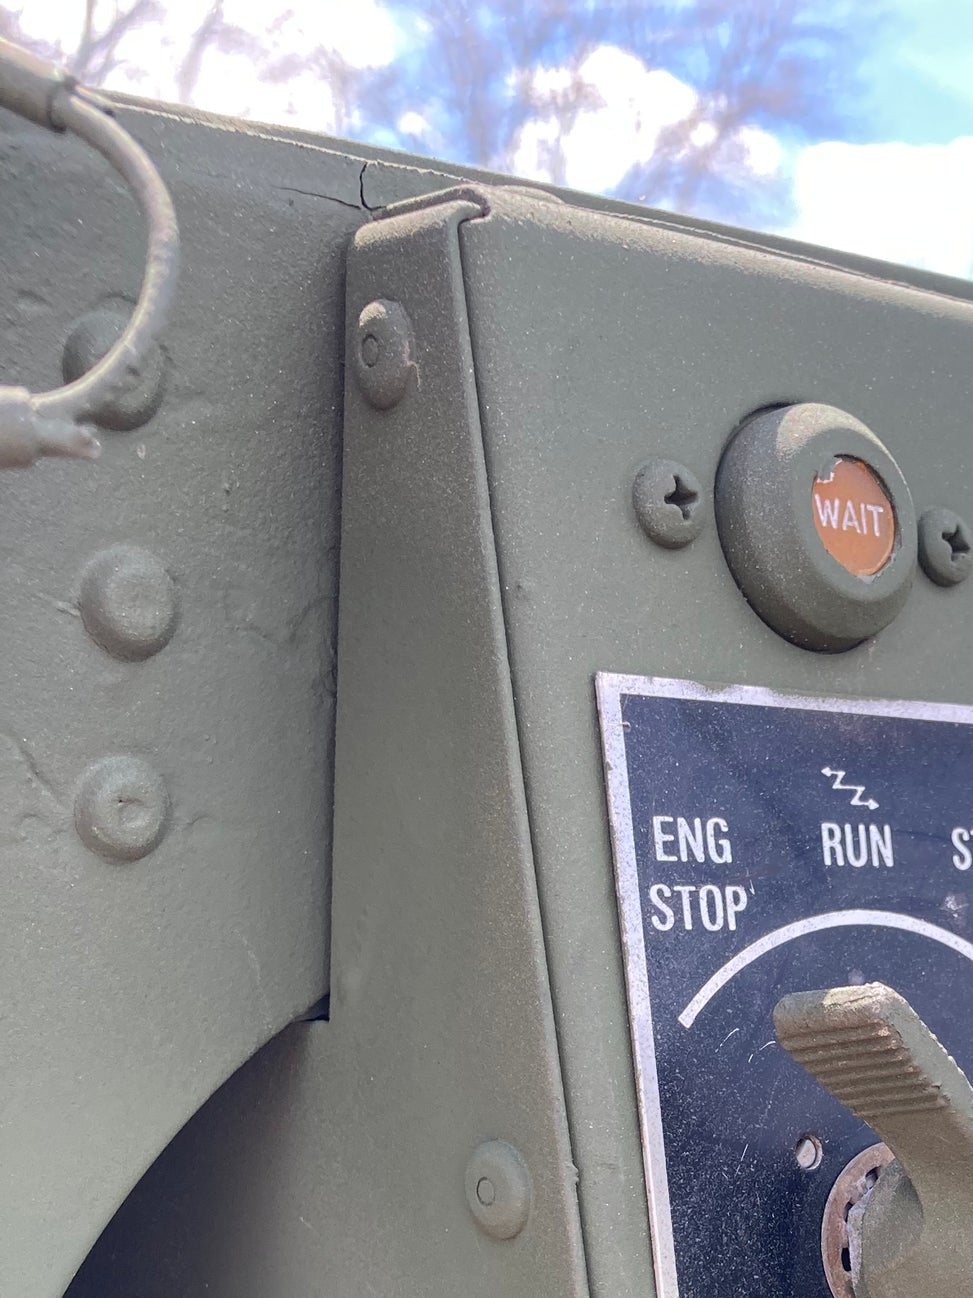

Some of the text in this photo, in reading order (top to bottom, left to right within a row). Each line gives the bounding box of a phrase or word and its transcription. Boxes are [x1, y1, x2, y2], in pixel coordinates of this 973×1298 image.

[813, 492, 885, 538] WAIT
[652, 816, 734, 864] ENG
[820, 821, 895, 868] RUN
[648, 884, 748, 932] STOP
